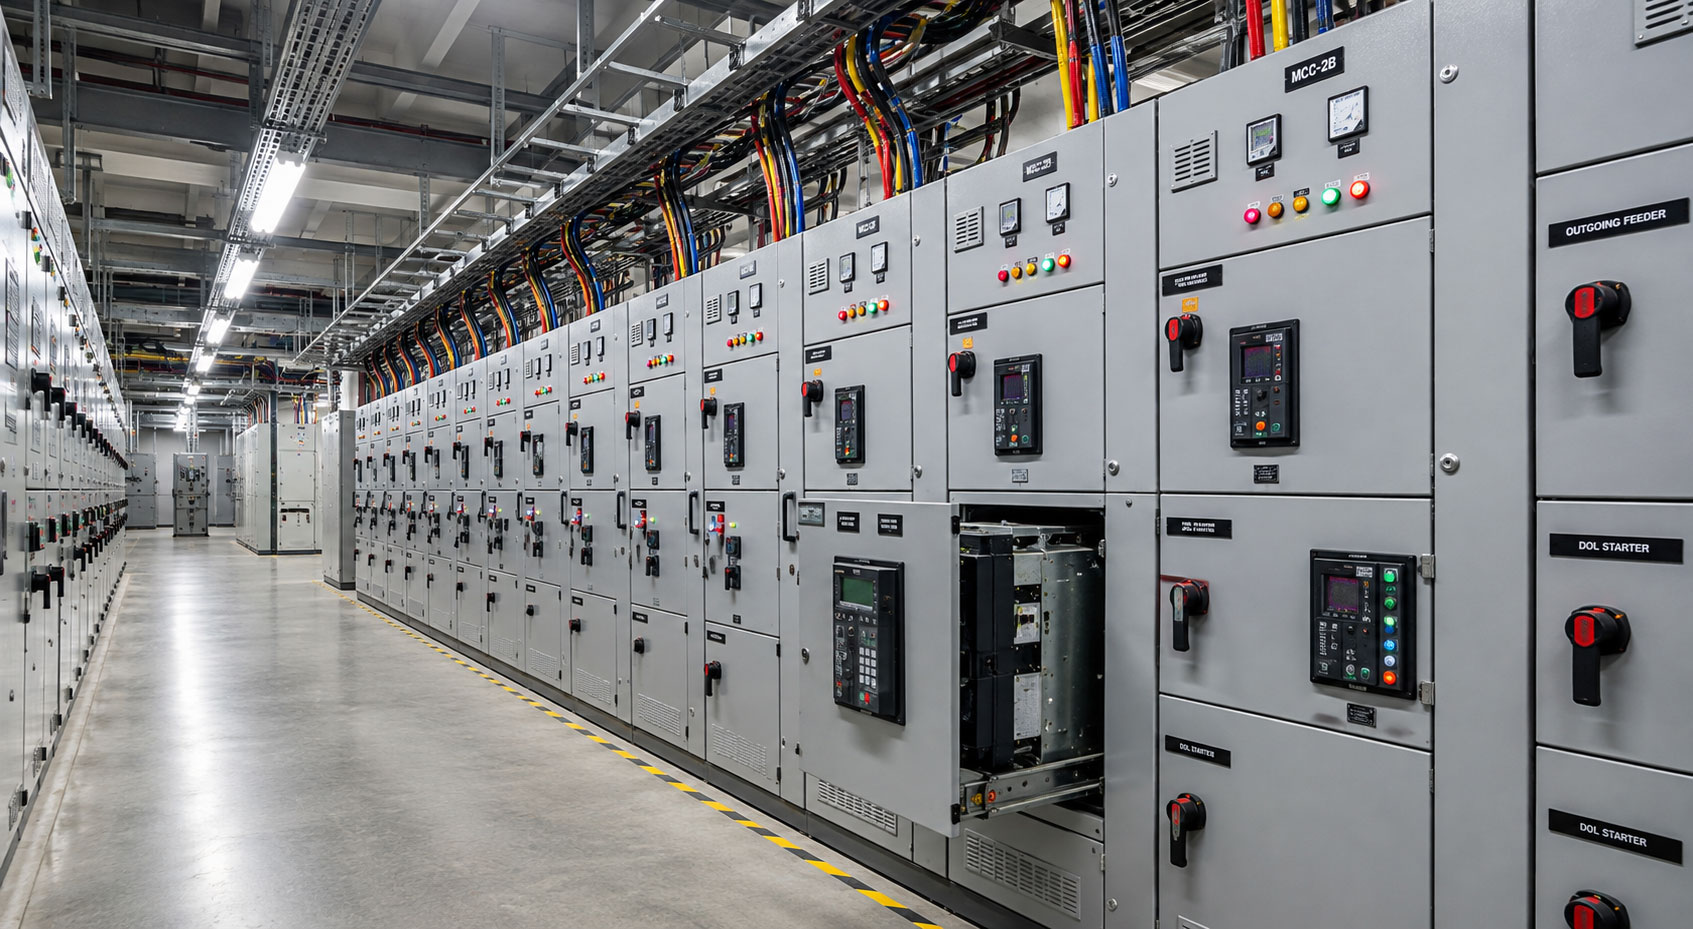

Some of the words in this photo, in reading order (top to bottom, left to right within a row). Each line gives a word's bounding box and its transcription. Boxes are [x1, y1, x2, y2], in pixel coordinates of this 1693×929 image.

[1291, 56, 1337, 84] MCC-2B
[1565, 217, 1621, 237] OUTGOING
[1623, 209, 1667, 226] FEEDER
[1578, 541, 1600, 551] DOL
[1602, 542, 1650, 553] STARTER
[1579, 822, 1600, 836] DOL
[1601, 828, 1648, 847] STARTER
